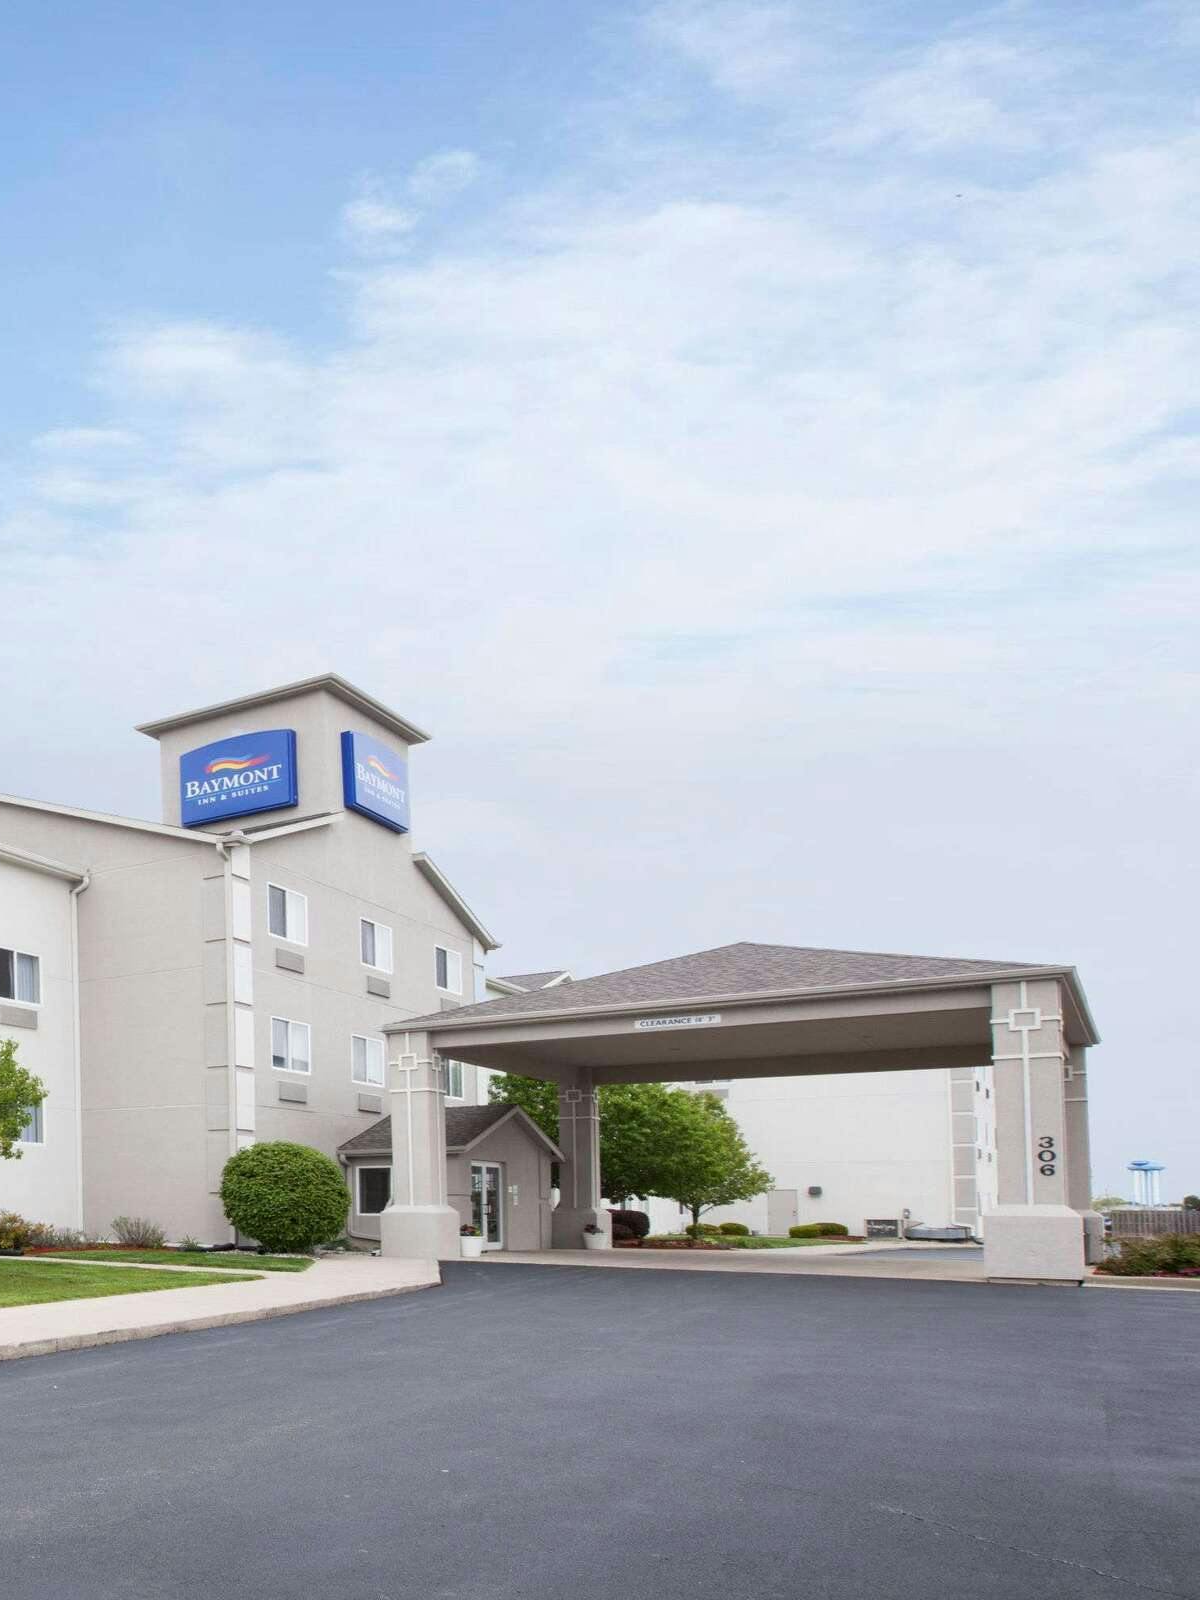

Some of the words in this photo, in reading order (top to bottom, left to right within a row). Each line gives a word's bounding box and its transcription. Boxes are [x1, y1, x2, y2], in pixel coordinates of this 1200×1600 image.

[185, 764, 282, 798] BAYMONT
[198, 796, 216, 806] INN
[232, 785, 269, 798] SUITES
[356, 762, 405, 803] BAYMONT
[640, 1017, 692, 1028] CLEARANCE
[1038, 1136, 1056, 1176] 306
